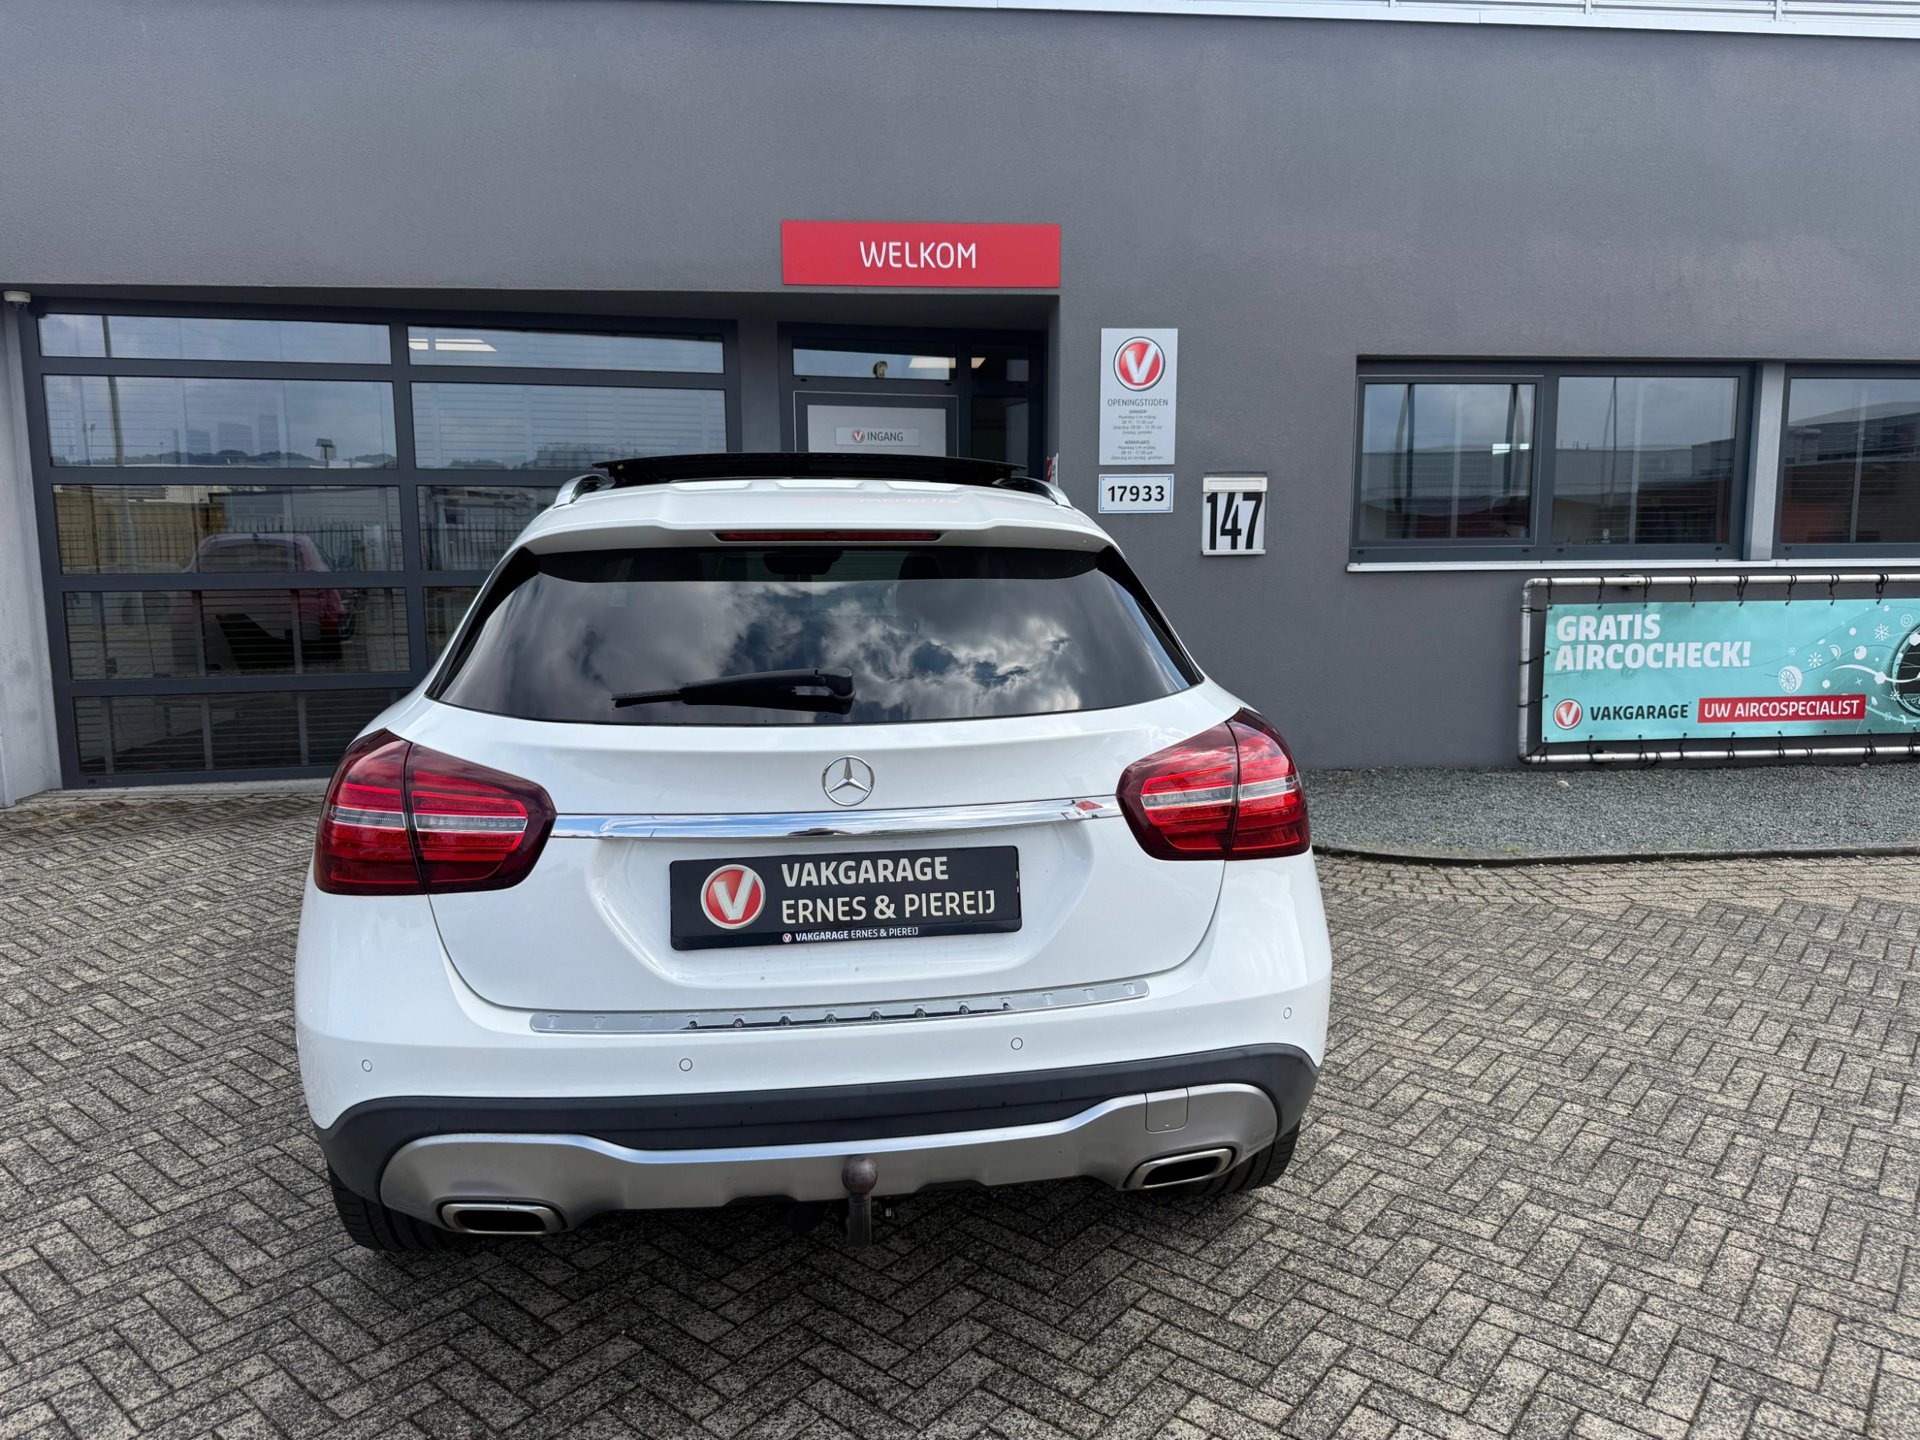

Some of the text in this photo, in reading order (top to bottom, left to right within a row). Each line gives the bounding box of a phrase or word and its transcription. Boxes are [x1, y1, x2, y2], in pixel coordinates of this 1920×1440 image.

[859, 240, 977, 269] WELKOM
[1107, 398, 1168, 407] OPENINGSTIJDEN
[867, 431, 904, 442] INGANG
[1107, 485, 1165, 502] 17933
[1206, 492, 1263, 550] 147
[1557, 614, 1661, 641] GRATIS
[1555, 642, 1750, 670] AIRCOCHECK!
[1590, 703, 1689, 722] VAKGARAGE
[1703, 699, 1861, 719] UW AIRCOSPECIALIST
[781, 856, 949, 888] VAKGARAGE
[782, 890, 996, 924] ERNES & PIEREIJ
[795, 931, 850, 941] VAKGARAGE
[850, 929, 878, 939] ERNES
[879, 929, 888, 938] &
[888, 927, 919, 937] PIEREIJ
